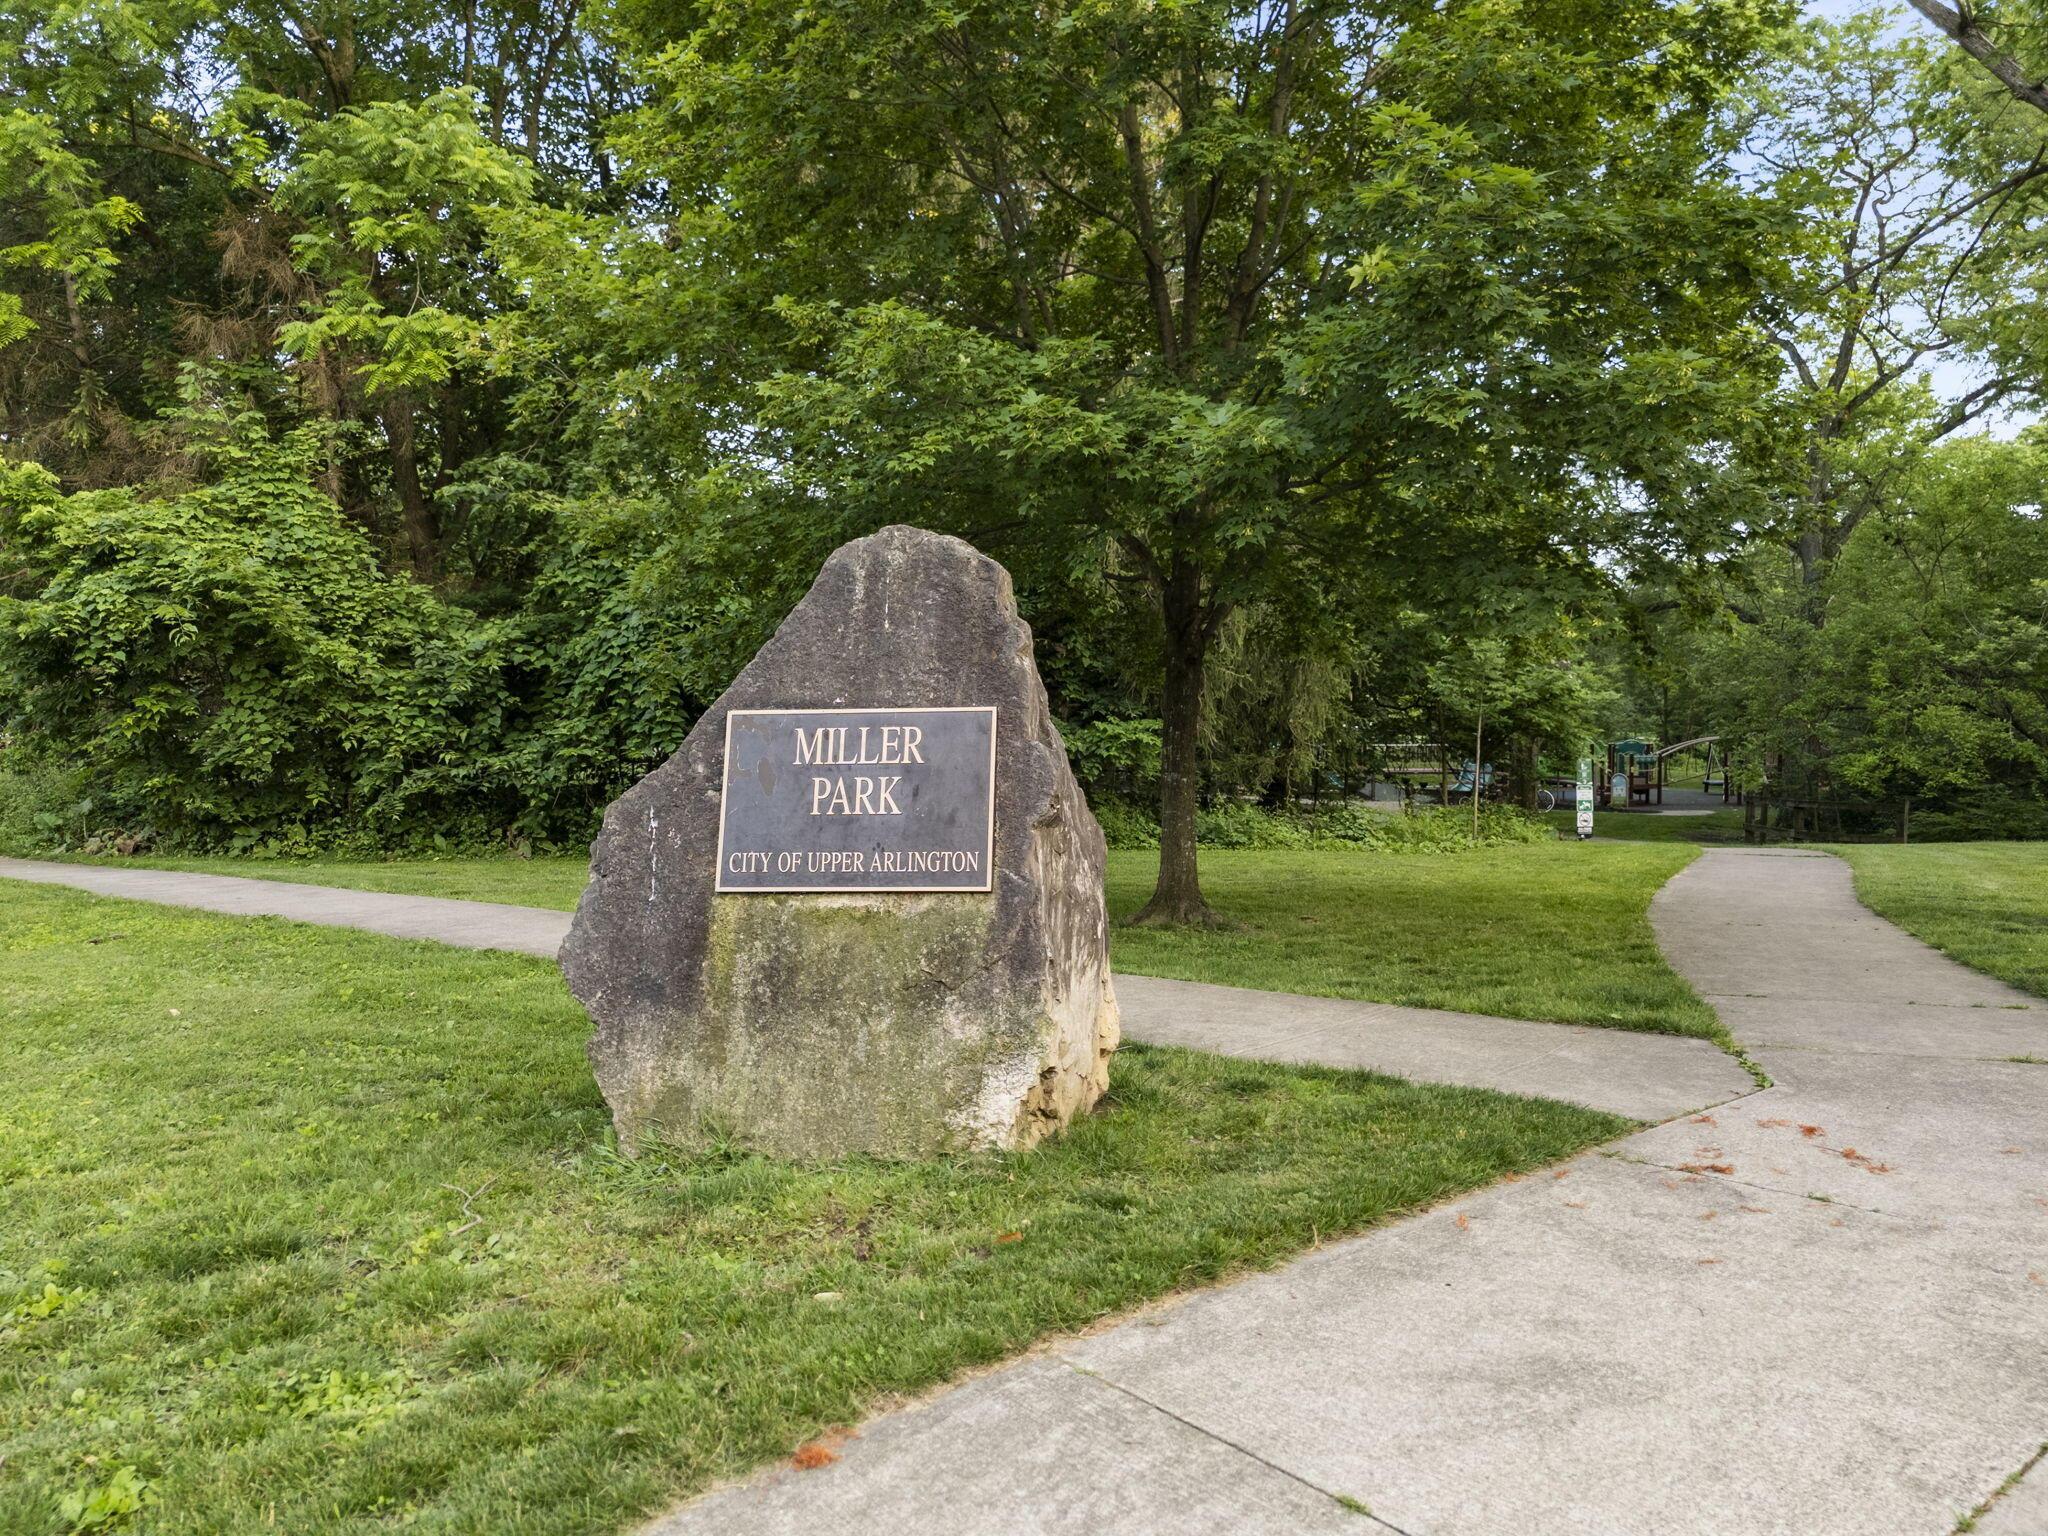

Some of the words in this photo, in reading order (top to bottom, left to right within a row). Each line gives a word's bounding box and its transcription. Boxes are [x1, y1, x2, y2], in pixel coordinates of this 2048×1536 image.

[793, 726, 924, 765] MILLER
[810, 776, 902, 816] PARK
[729, 852, 773, 873] CITY
[777, 852, 802, 873] OF
[807, 852, 865, 873] UPPER
[870, 851, 979, 873] ARLINGTON
